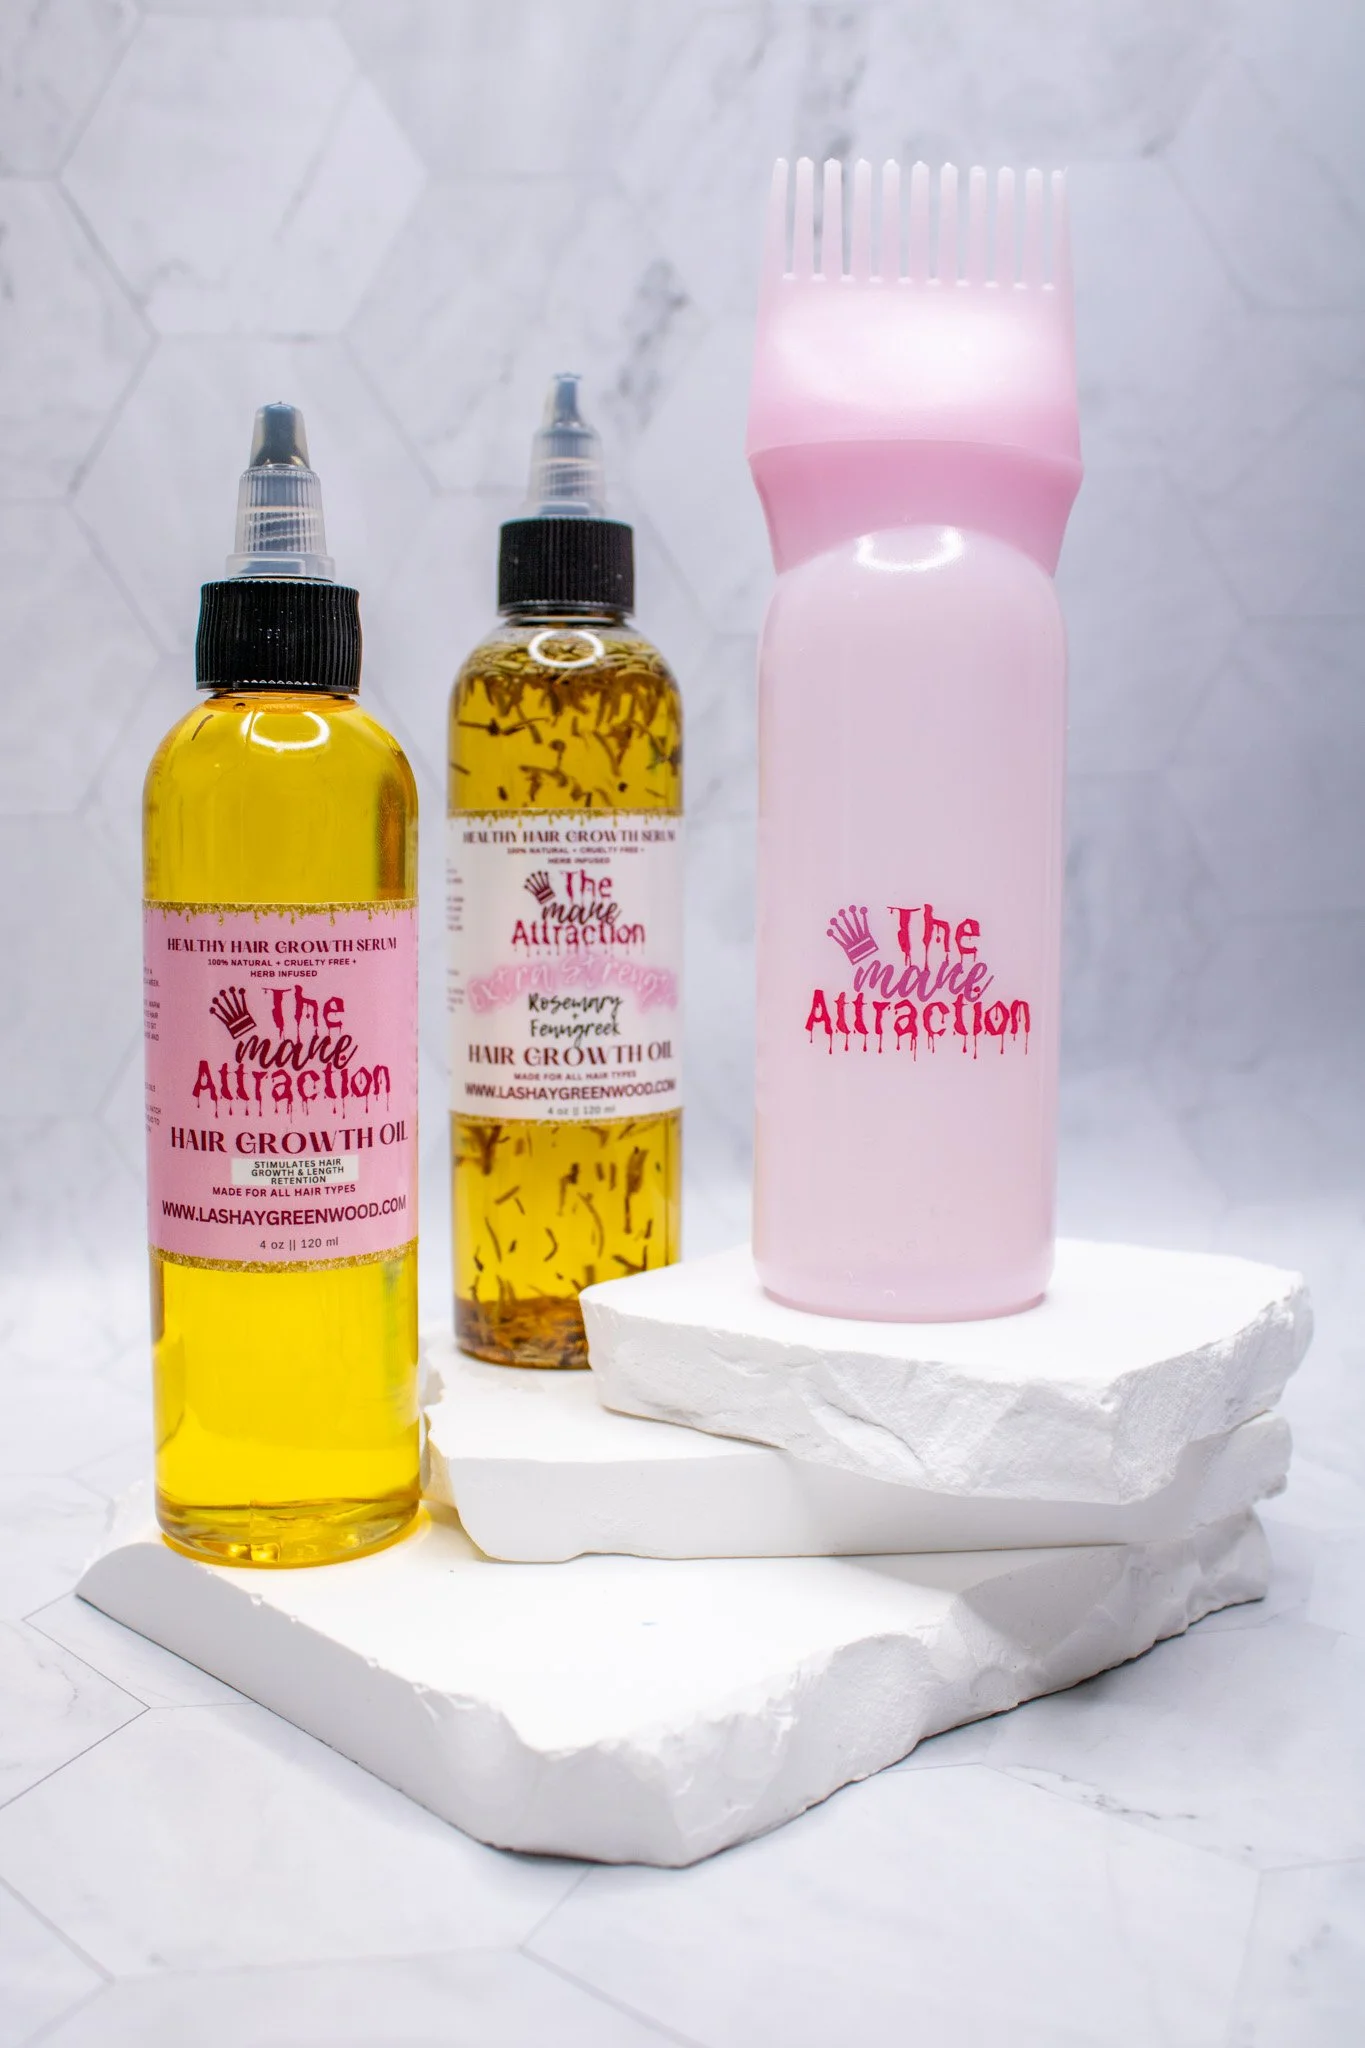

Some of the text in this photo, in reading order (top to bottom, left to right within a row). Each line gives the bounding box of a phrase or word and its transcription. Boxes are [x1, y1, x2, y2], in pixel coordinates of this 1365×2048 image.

[463, 829, 676, 844] HEALTHY HAIR GROWTH SERUM
[560, 869, 613, 900] The
[542, 901, 622, 925] mane
[511, 919, 646, 951] Attraction
[887, 904, 981, 959] The
[168, 937, 398, 954] HEALTHY HAIR GROWTH SERUM
[208, 958, 228, 966] 100%
[328, 958, 350, 966] FREE
[250, 970, 318, 978] HERB INFUSED
[853, 960, 994, 1002] mane
[262, 984, 345, 1034] The
[528, 992, 622, 1020] Rosemary
[805, 989, 1030, 1052] Attraction
[235, 1034, 358, 1071] mane
[468, 1040, 673, 1066] HAIR GROWTH OIL
[192, 1060, 391, 1111] Attraction
[514, 1072, 540, 1080] MADE
[586, 1072, 608, 1080] HAIR
[612, 1070, 636, 1078] TYPES
[465, 1078, 676, 1100] WWW.LASHAYGREENWOOD.COM
[584, 1106, 602, 1114] 120
[604, 1105, 616, 1113] ml
[171, 1120, 409, 1154] HAIR GROWTH OIL
[251, 1166, 344, 1177] GROWTH & LENGTH
[254, 1158, 342, 1169] STIMULATES HAIR
[212, 1184, 356, 1197] MADE FOR ALL HAIR TYPES
[270, 1176, 326, 1185] RETENTION
[162, 1195, 406, 1226] WWW.LASHAYGREENWOOD.COM
[260, 1240, 266, 1249] 4
[270, 1241, 284, 1250] oz
[301, 1238, 322, 1248] 120
[326, 1237, 339, 1247] ml
